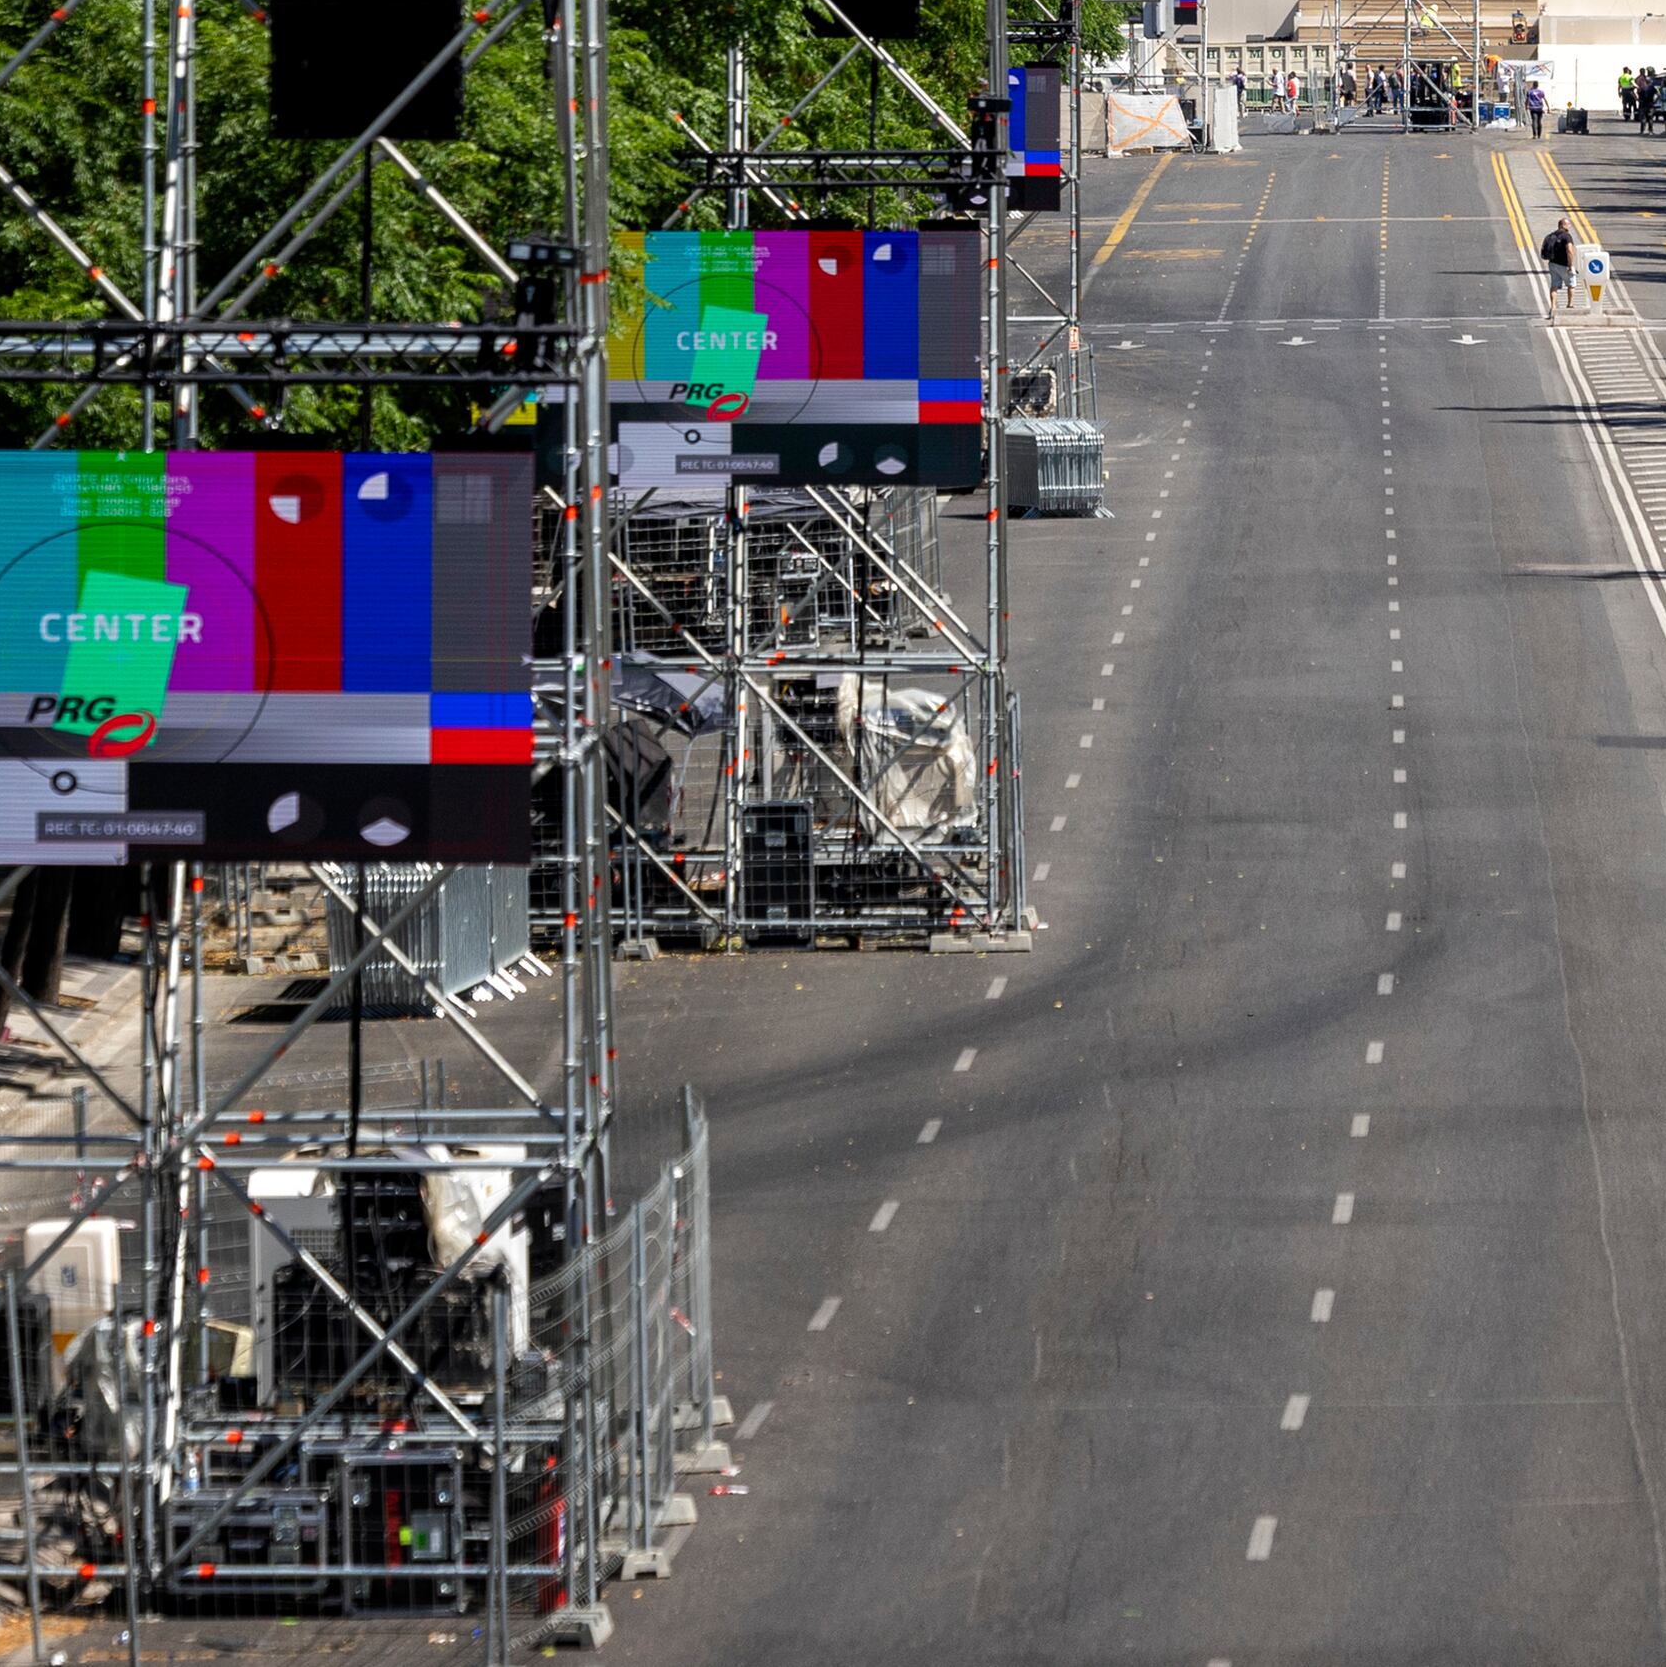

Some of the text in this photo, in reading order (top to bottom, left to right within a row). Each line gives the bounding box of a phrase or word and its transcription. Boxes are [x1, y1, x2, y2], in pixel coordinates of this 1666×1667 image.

[676, 330, 779, 351] CENTER
[669, 383, 725, 400] PRG
[39, 612, 203, 645] CENTER
[26, 696, 117, 724] PRG
[44, 821, 75, 836] REC
